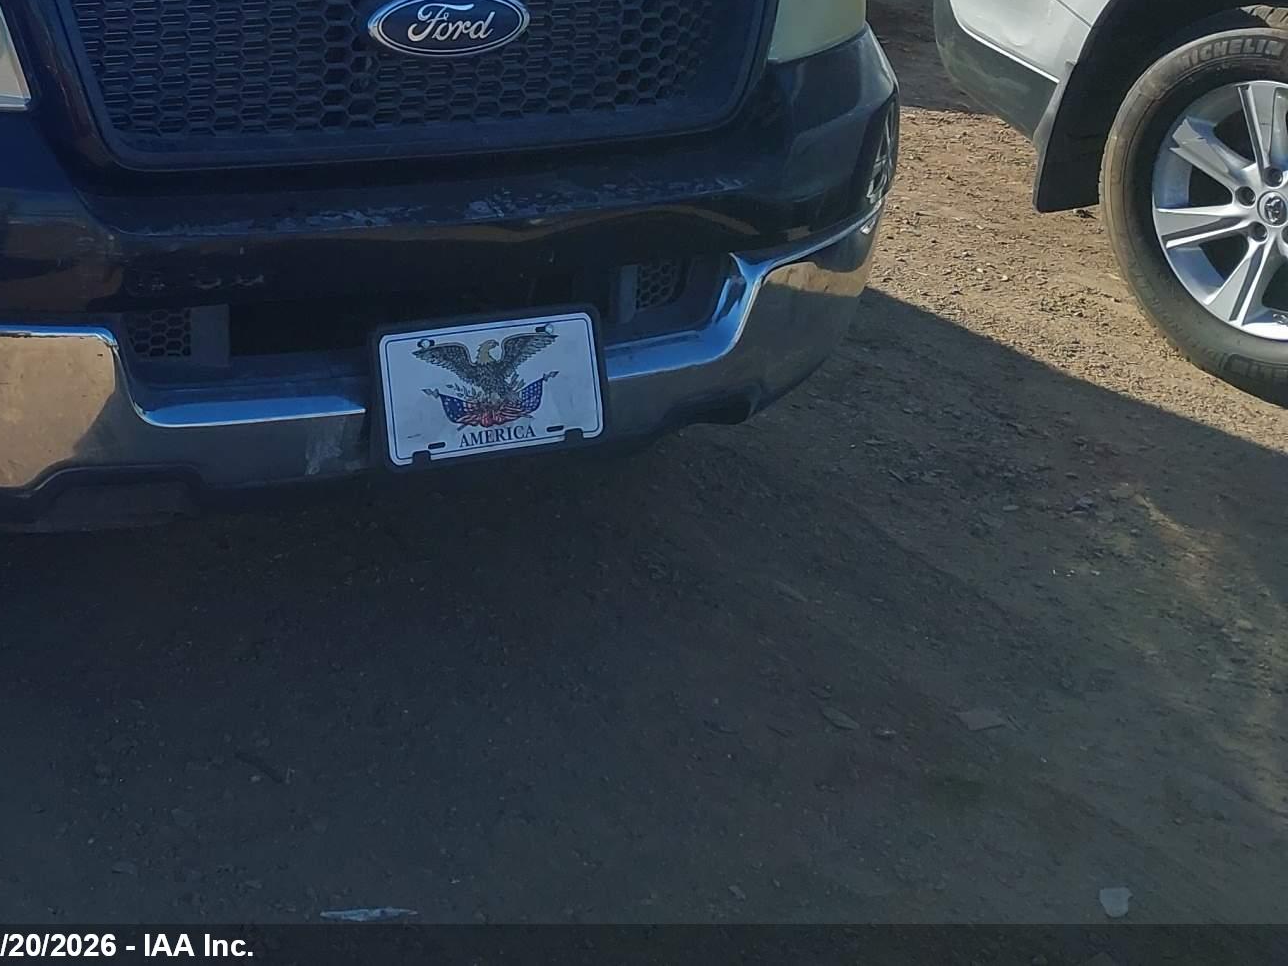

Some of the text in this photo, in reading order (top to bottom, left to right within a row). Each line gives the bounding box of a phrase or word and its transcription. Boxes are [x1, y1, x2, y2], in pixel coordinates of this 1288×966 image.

[407, 2, 496, 42] Ford
[1177, 38, 1286, 71] MICHELIN
[459, 425, 537, 448] AMERICA
